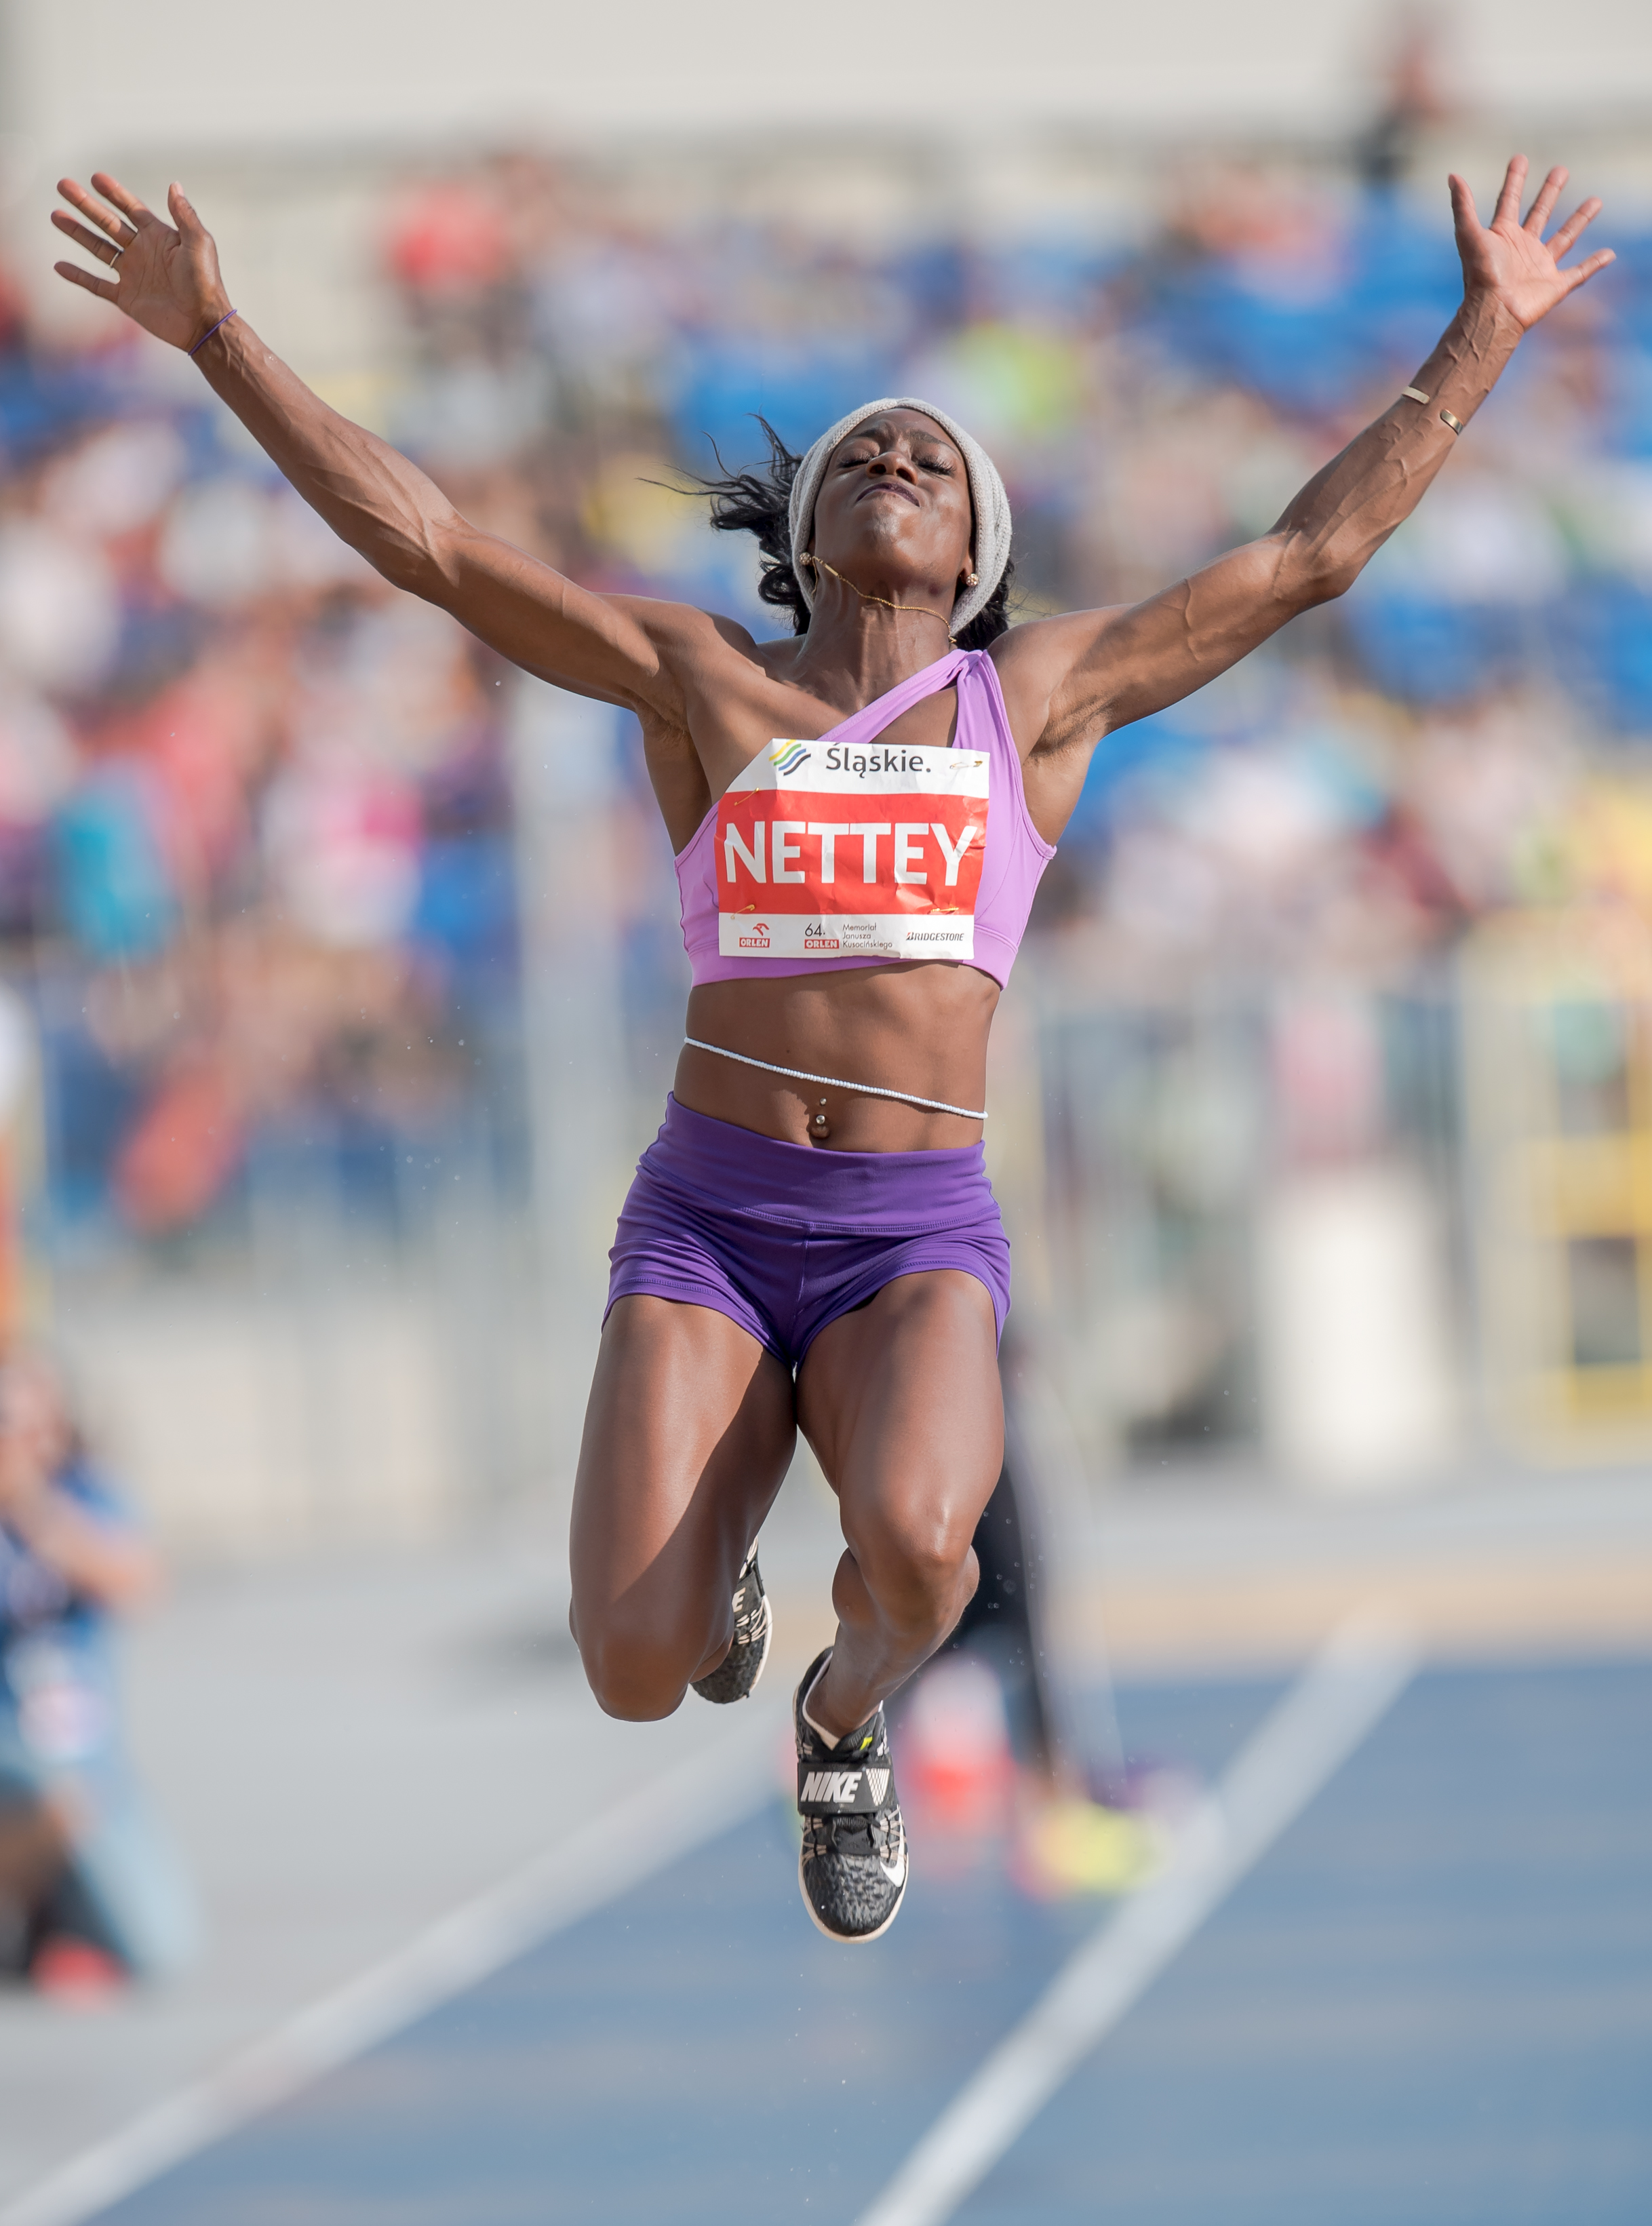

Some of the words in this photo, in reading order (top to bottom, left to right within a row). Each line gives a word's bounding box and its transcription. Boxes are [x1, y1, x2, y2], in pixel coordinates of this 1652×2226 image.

[825, 742, 931, 778] Śląskie.
[724, 821, 978, 886] NETTEY
[804, 922, 825, 937] 64.
[842, 922, 877, 931] Memoriał
[905, 932, 964, 941] BRIDGESTONE
[740, 938, 768, 948] ORLEN
[806, 940, 838, 948] ORLEN
[843, 941, 892, 950] Kusocińskiego
[800, 1771, 863, 1803] NIKE
